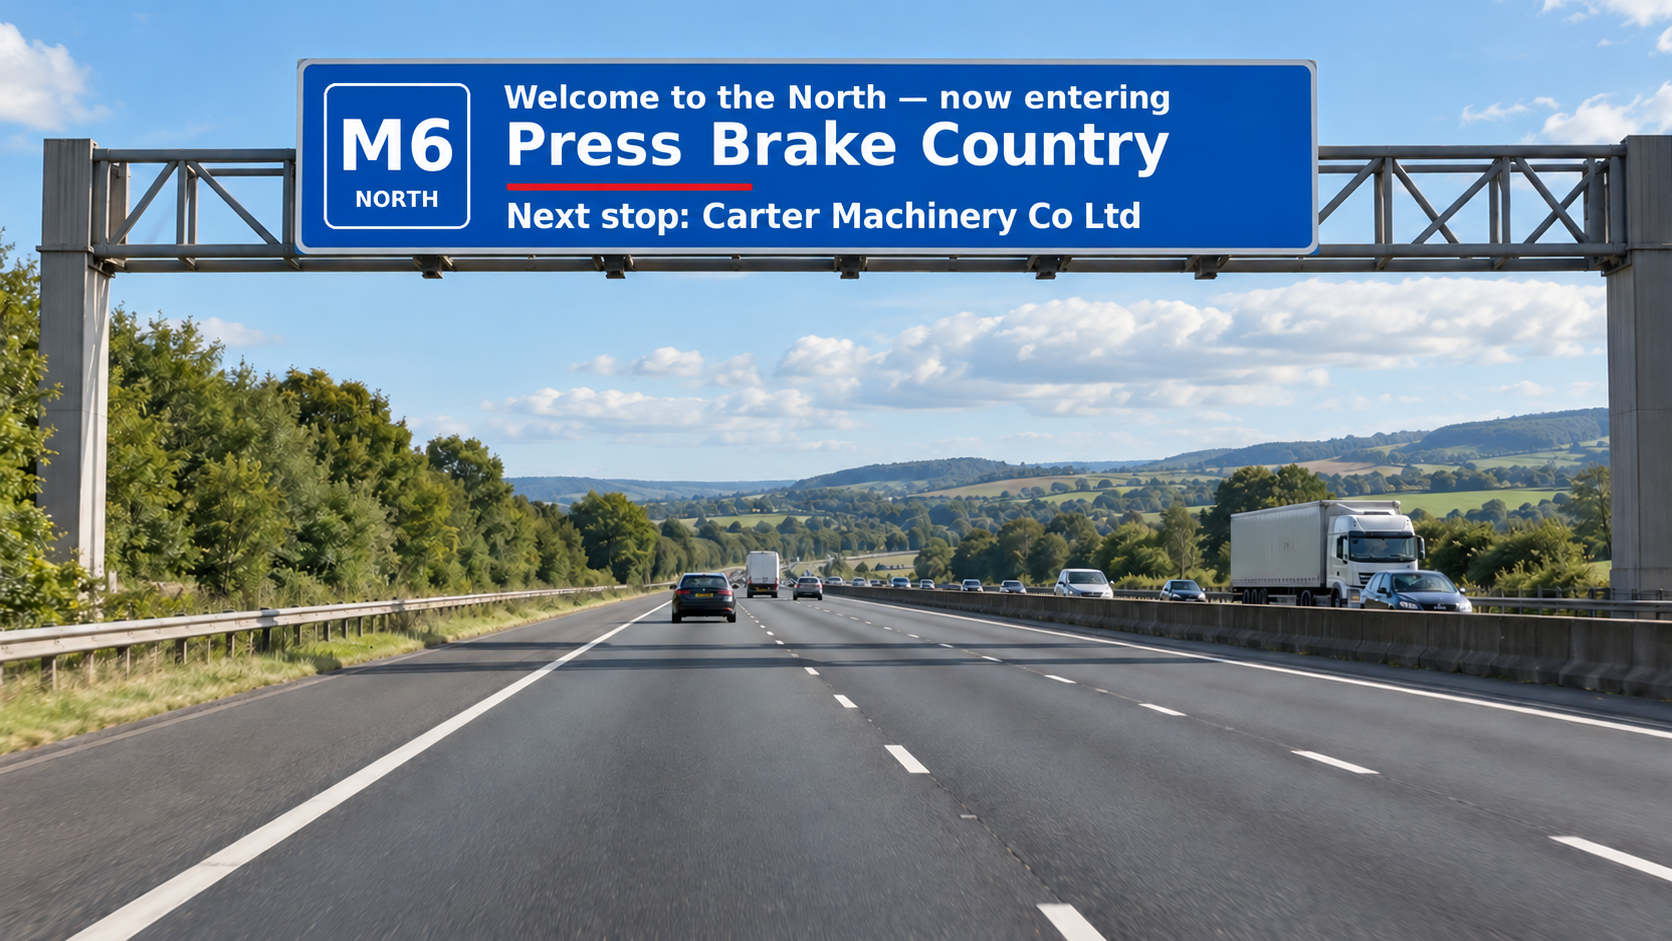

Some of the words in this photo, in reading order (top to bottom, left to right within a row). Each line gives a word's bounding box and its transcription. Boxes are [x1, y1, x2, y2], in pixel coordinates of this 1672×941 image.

[505, 84, 659, 110] Welcome
[671, 86, 705, 110] to
[717, 84, 774, 110] the
[790, 84, 885, 110] North
[941, 90, 1012, 110] now
[1025, 84, 1170, 116] entering
[344, 118, 452, 172] M6
[508, 121, 681, 167] Press
[713, 119, 896, 167] Brake
[922, 121, 1170, 178] Country
[356, 191, 438, 207] NORTH
[508, 202, 590, 229] Next
[602, 203, 688, 236] stop:
[702, 201, 820, 229] Carter
[833, 201, 1017, 236] Machinery
[1029, 202, 1072, 229] Co
[1086, 201, 1140, 229] Ltd
